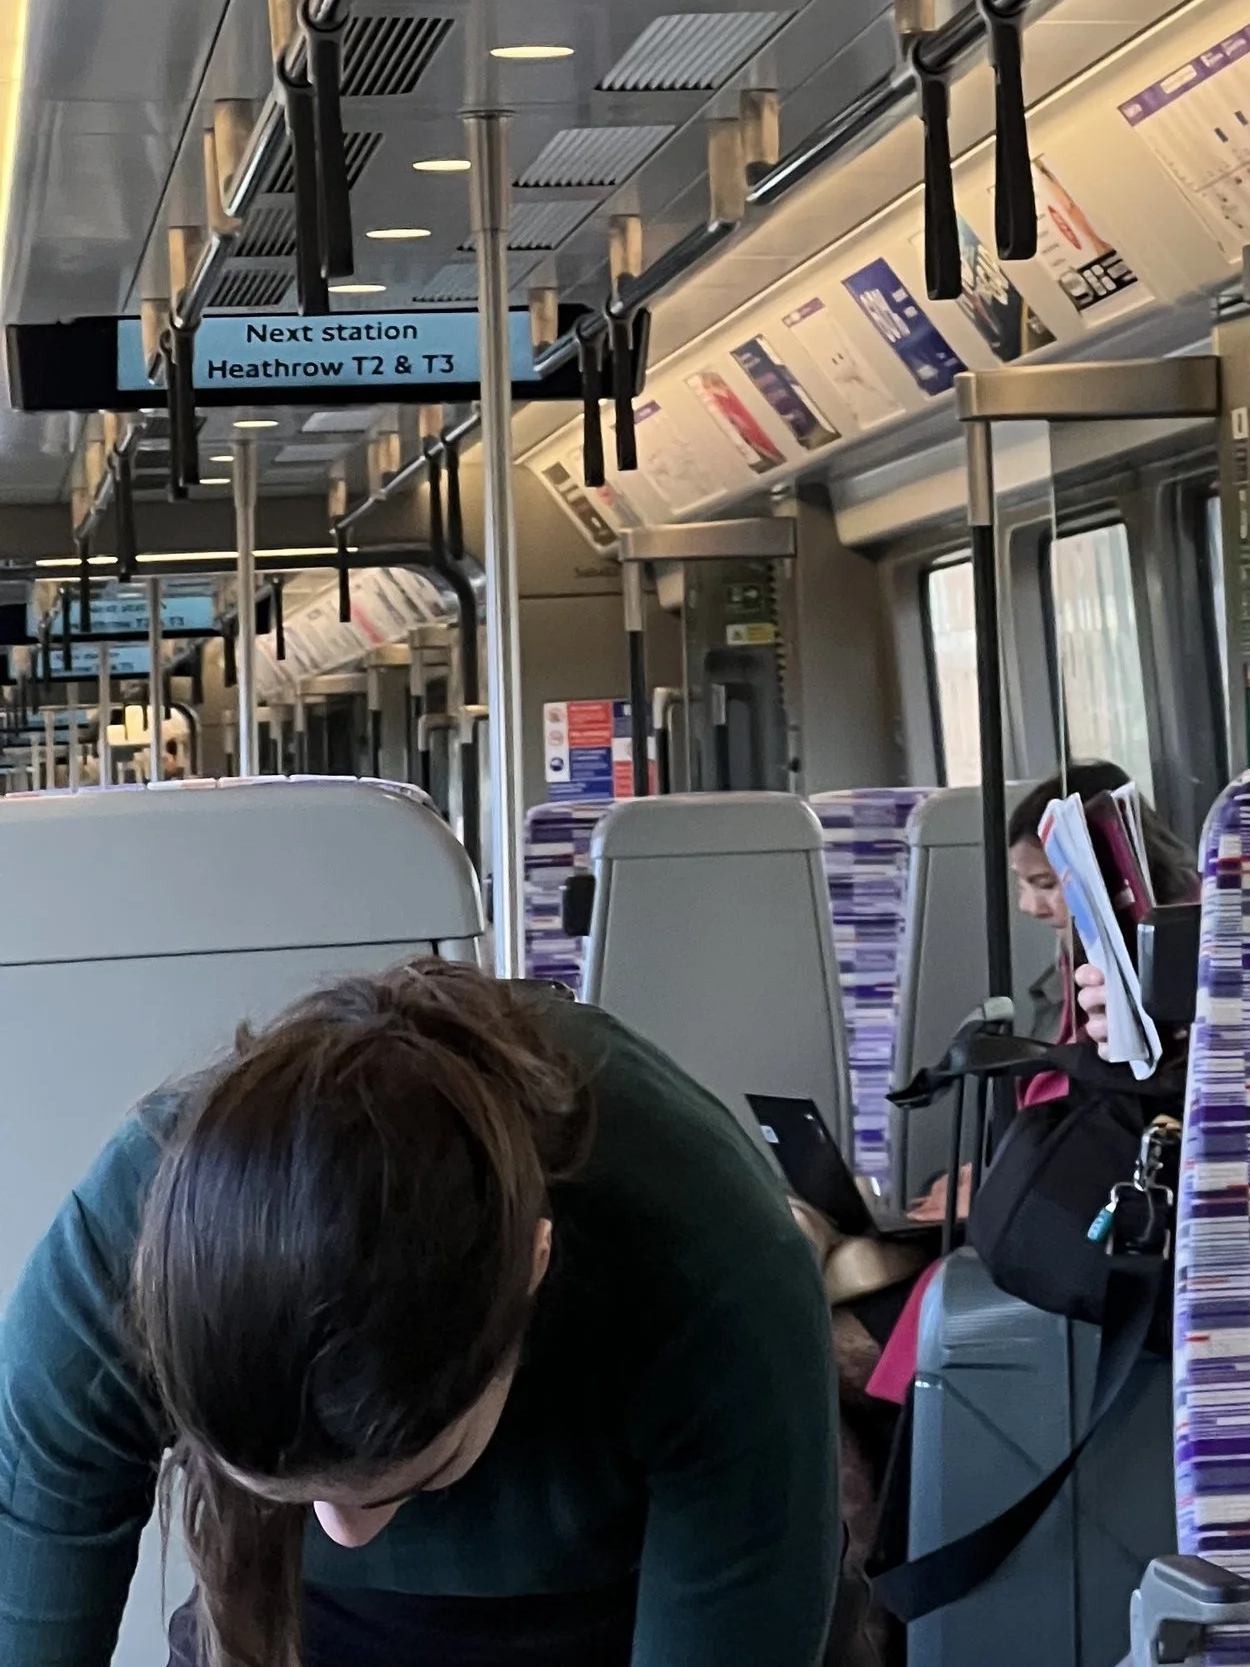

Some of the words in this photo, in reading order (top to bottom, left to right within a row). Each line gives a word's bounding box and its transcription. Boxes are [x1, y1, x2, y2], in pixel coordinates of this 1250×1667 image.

[247, 324, 313, 343] Next
[322, 322, 418, 342] station
[208, 359, 343, 379] Heathrow
[353, 356, 384, 375] T2
[394, 355, 412, 374] &
[423, 355, 454, 374] T3
